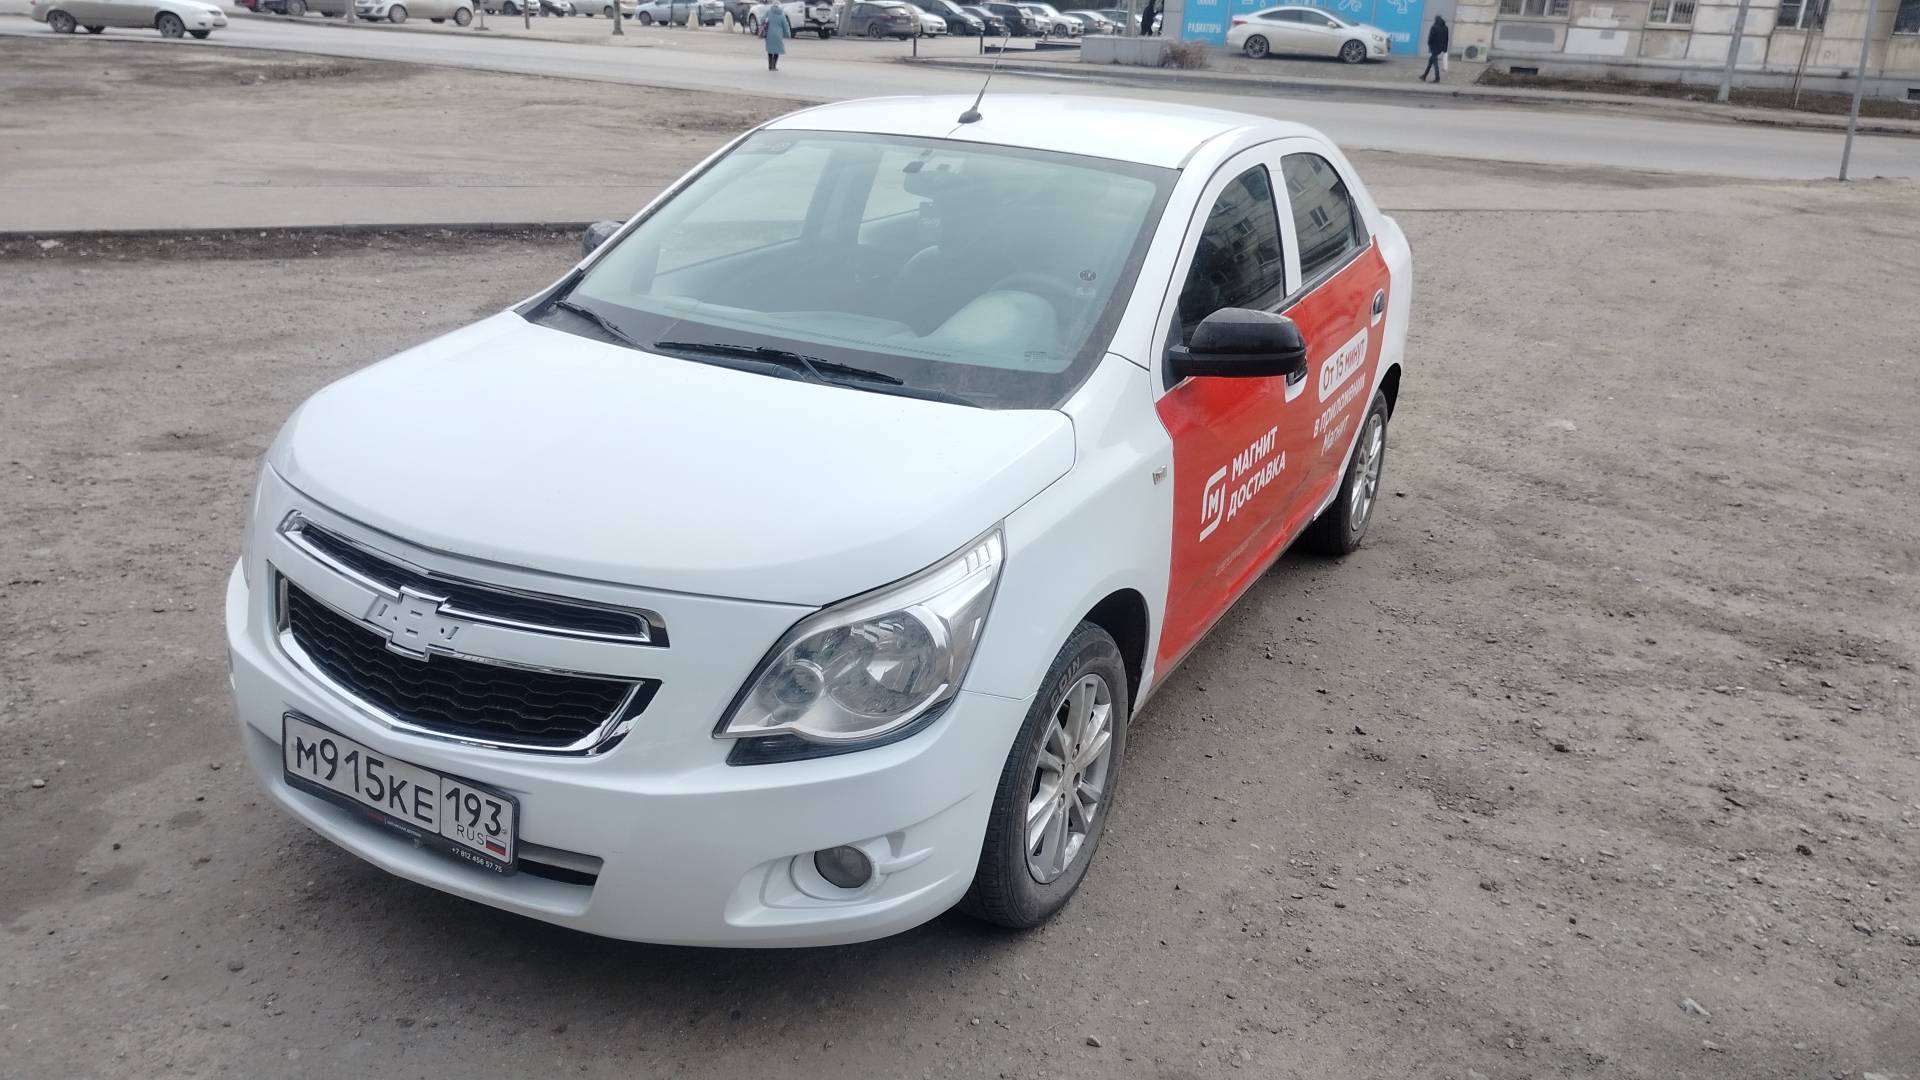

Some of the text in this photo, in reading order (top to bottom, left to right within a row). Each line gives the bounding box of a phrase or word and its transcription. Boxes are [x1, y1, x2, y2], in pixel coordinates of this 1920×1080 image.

[1187, 22, 1222, 34] РАДИАТОРЫ
[1323, 338, 1365, 391] От 15 минут
[1232, 425, 1278, 482] МАГНИТ
[1227, 449, 1286, 522] ДОСТАВКА
[296, 736, 502, 837] М915КЕ 193
[457, 824, 485, 846] RUS
[460, 850, 471, 860] 812
